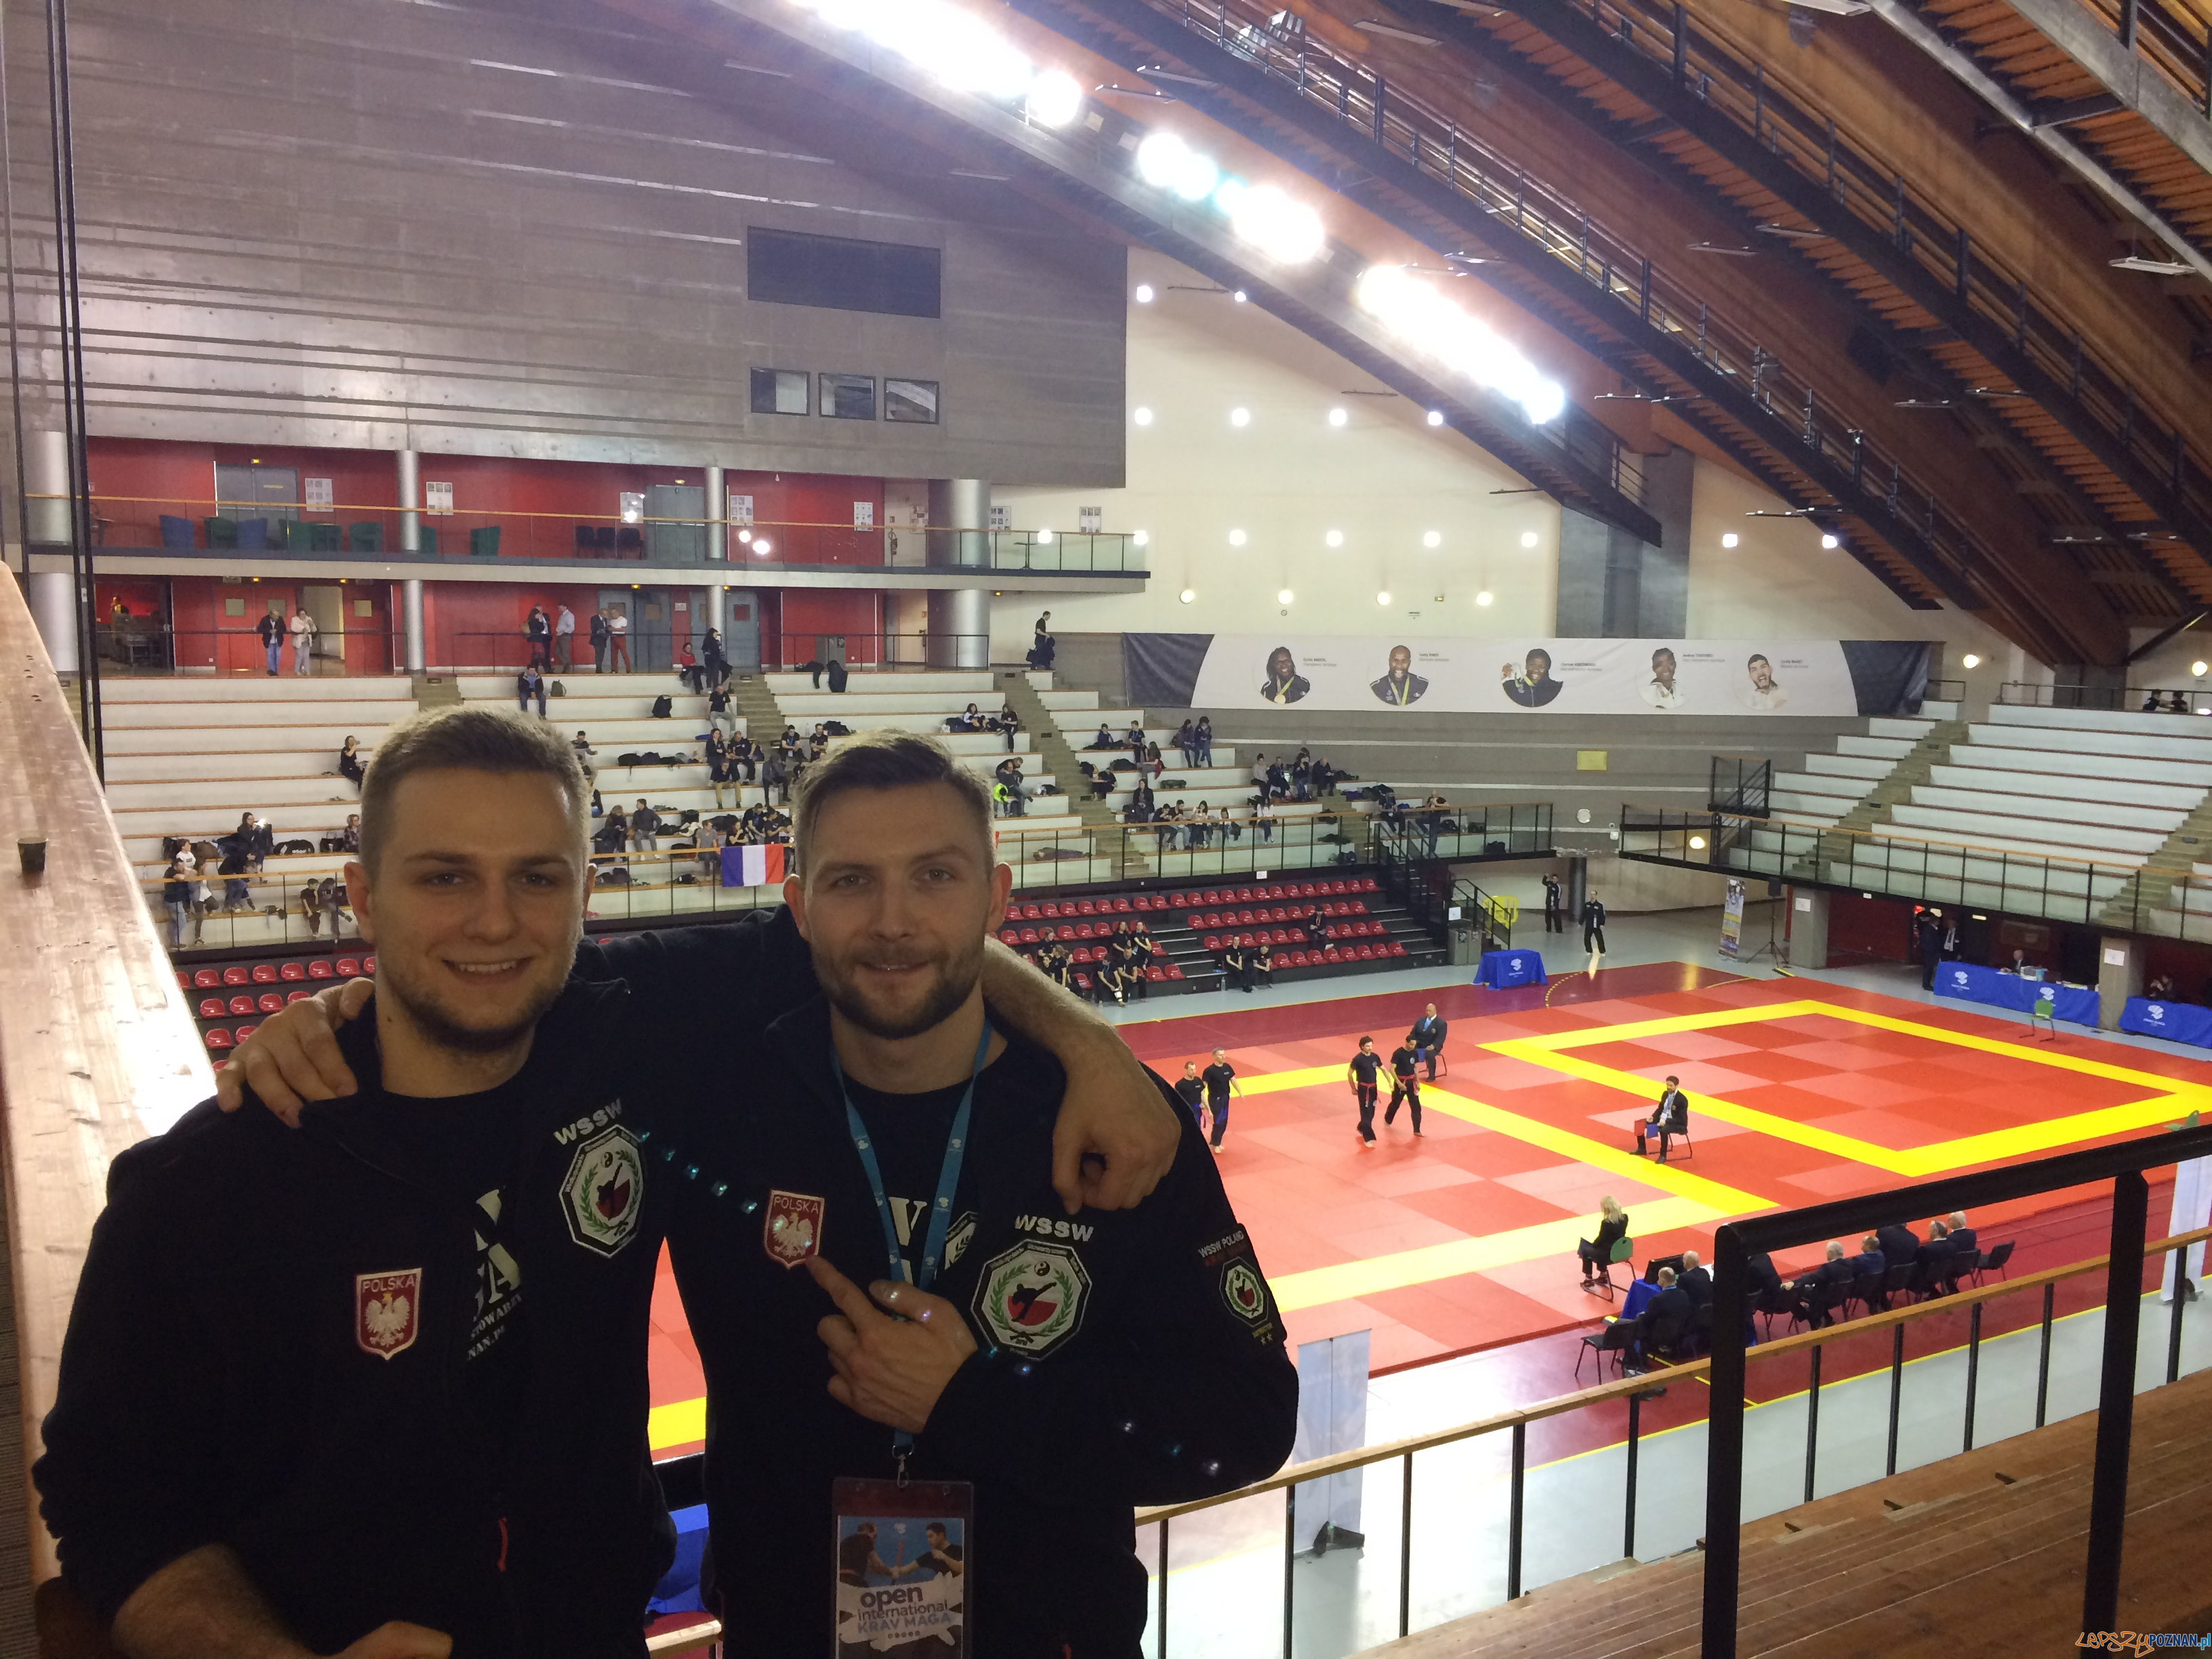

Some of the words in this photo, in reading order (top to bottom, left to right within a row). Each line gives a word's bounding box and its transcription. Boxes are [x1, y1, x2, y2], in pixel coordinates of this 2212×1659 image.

[553, 1097, 622, 1145] WSSW
[774, 1196, 819, 1214] POLSKA
[1014, 1214, 1094, 1242] WSSW
[1197, 1240, 1223, 1258] WSSW
[1221, 1229, 1244, 1248] POLAND
[362, 1275, 415, 1294] POLSKA
[857, 1599, 948, 1621] international
[860, 1586, 923, 1612] open
[857, 1617, 900, 1634] KRAV
[904, 1612, 951, 1628] MAGA
